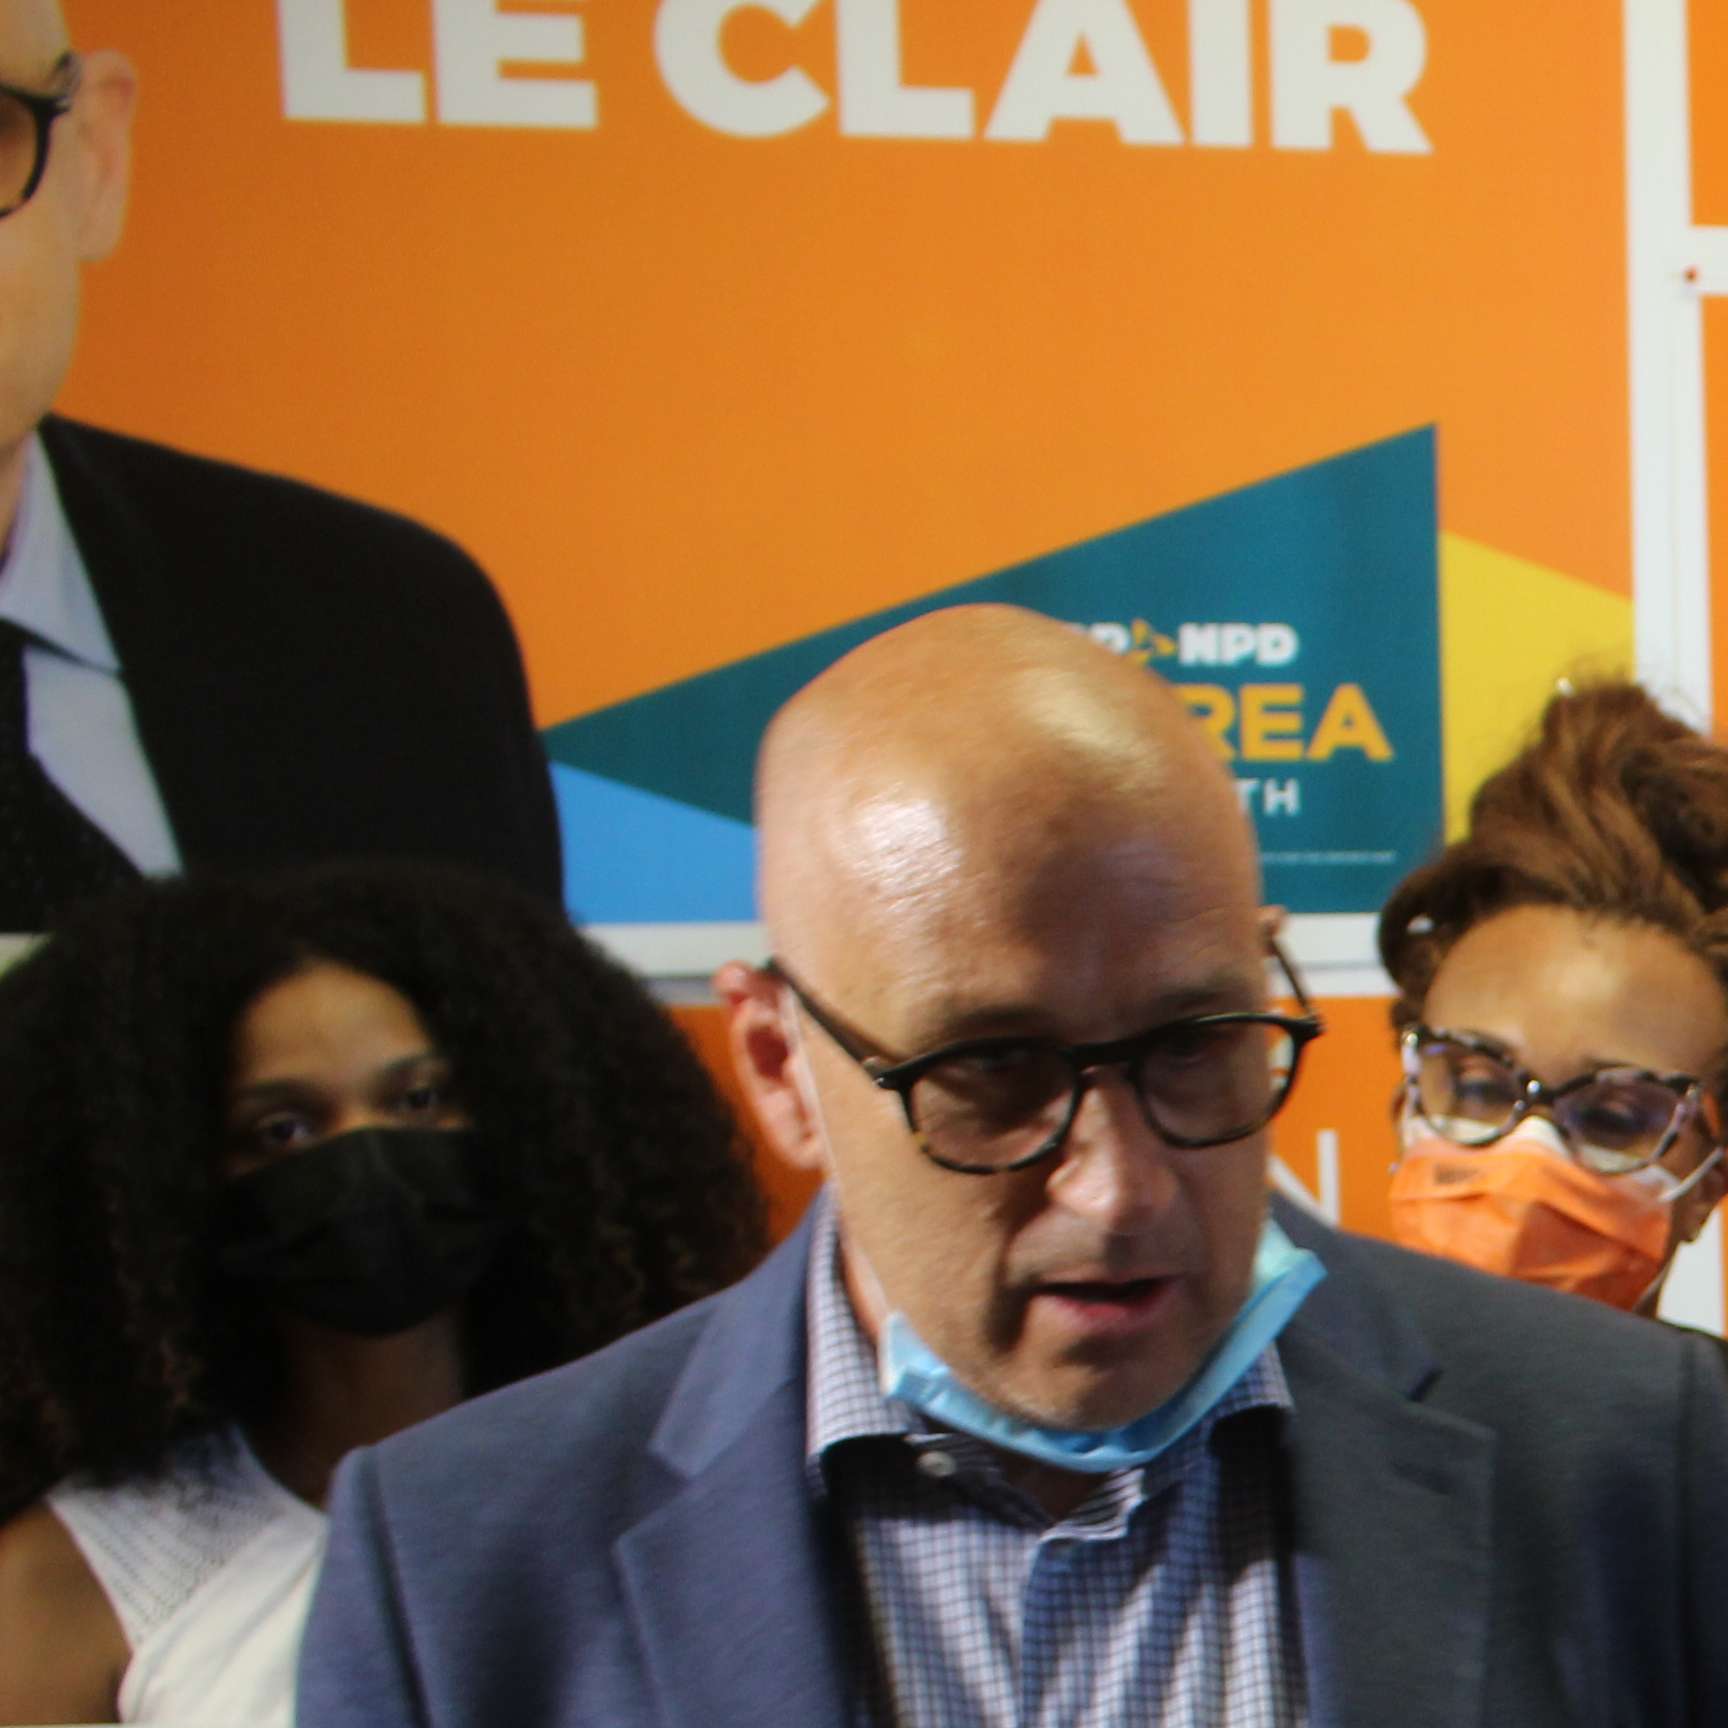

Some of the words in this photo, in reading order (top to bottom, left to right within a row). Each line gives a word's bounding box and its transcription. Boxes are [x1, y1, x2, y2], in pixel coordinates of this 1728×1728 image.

[279, 0, 599, 128] LE
[654, 0, 1432, 155] CLAIR
[1178, 621, 1300, 667] NPD
